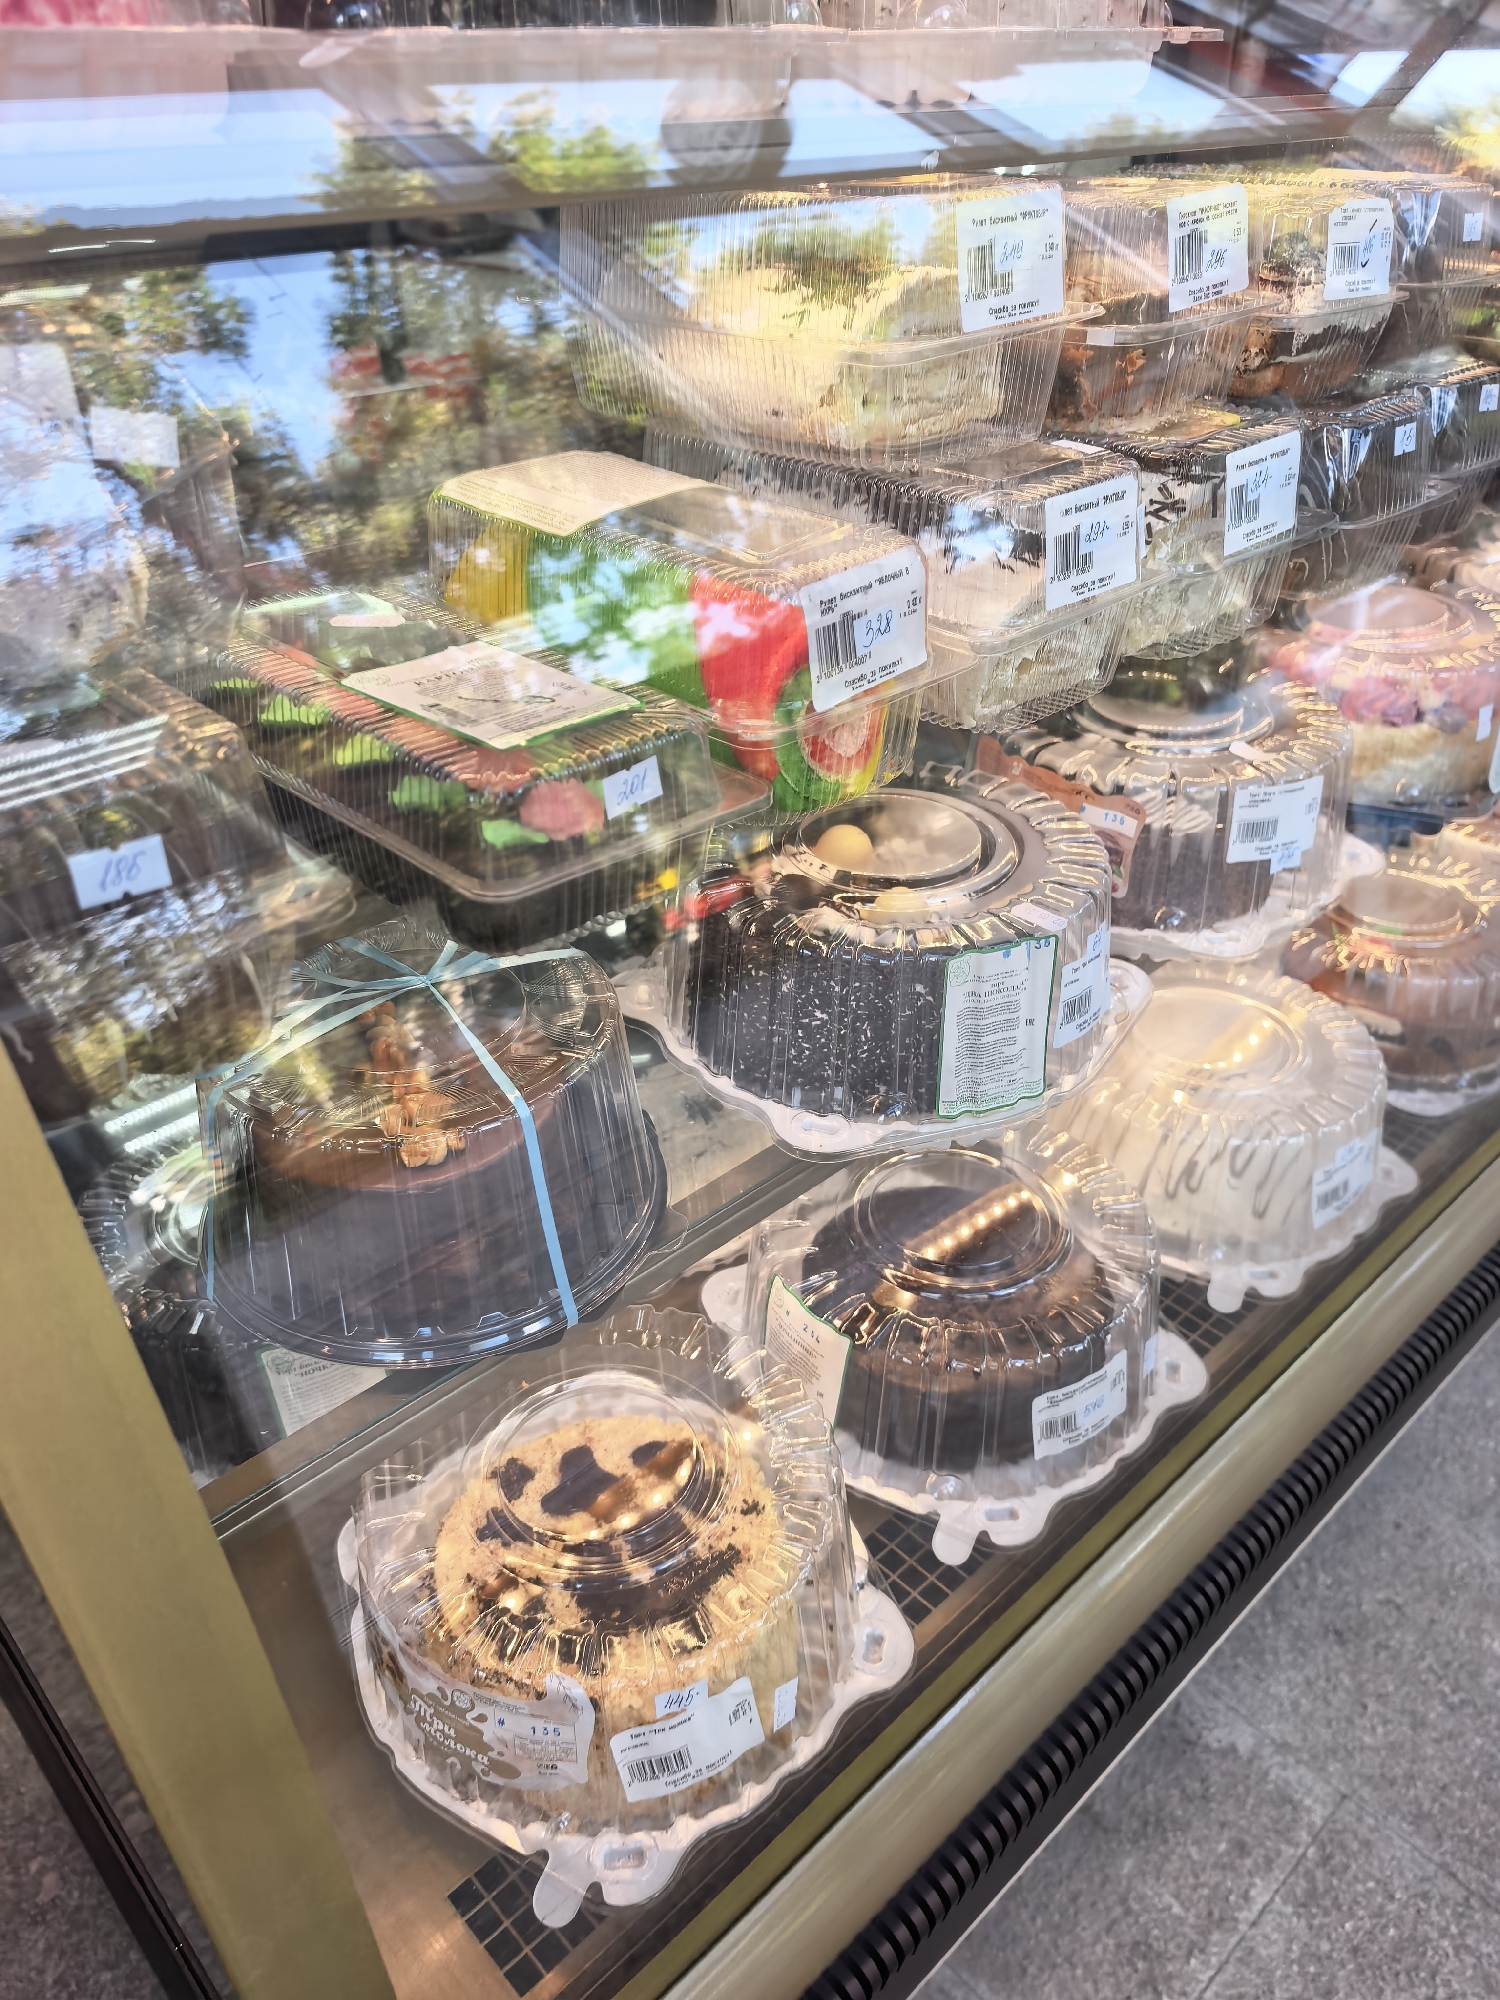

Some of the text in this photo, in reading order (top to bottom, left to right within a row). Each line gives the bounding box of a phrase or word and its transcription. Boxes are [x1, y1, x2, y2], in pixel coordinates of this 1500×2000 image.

[820, 596, 837, 608] Рулет
[840, 581, 873, 601] бисквитный
[863, 609, 893, 648] 328
[844, 672, 868, 688] Спасибо
[870, 670, 877, 678] за
[617, 767, 647, 805] 201
[407, 1694, 456, 1737] Три
[420, 1721, 490, 1765] молока
